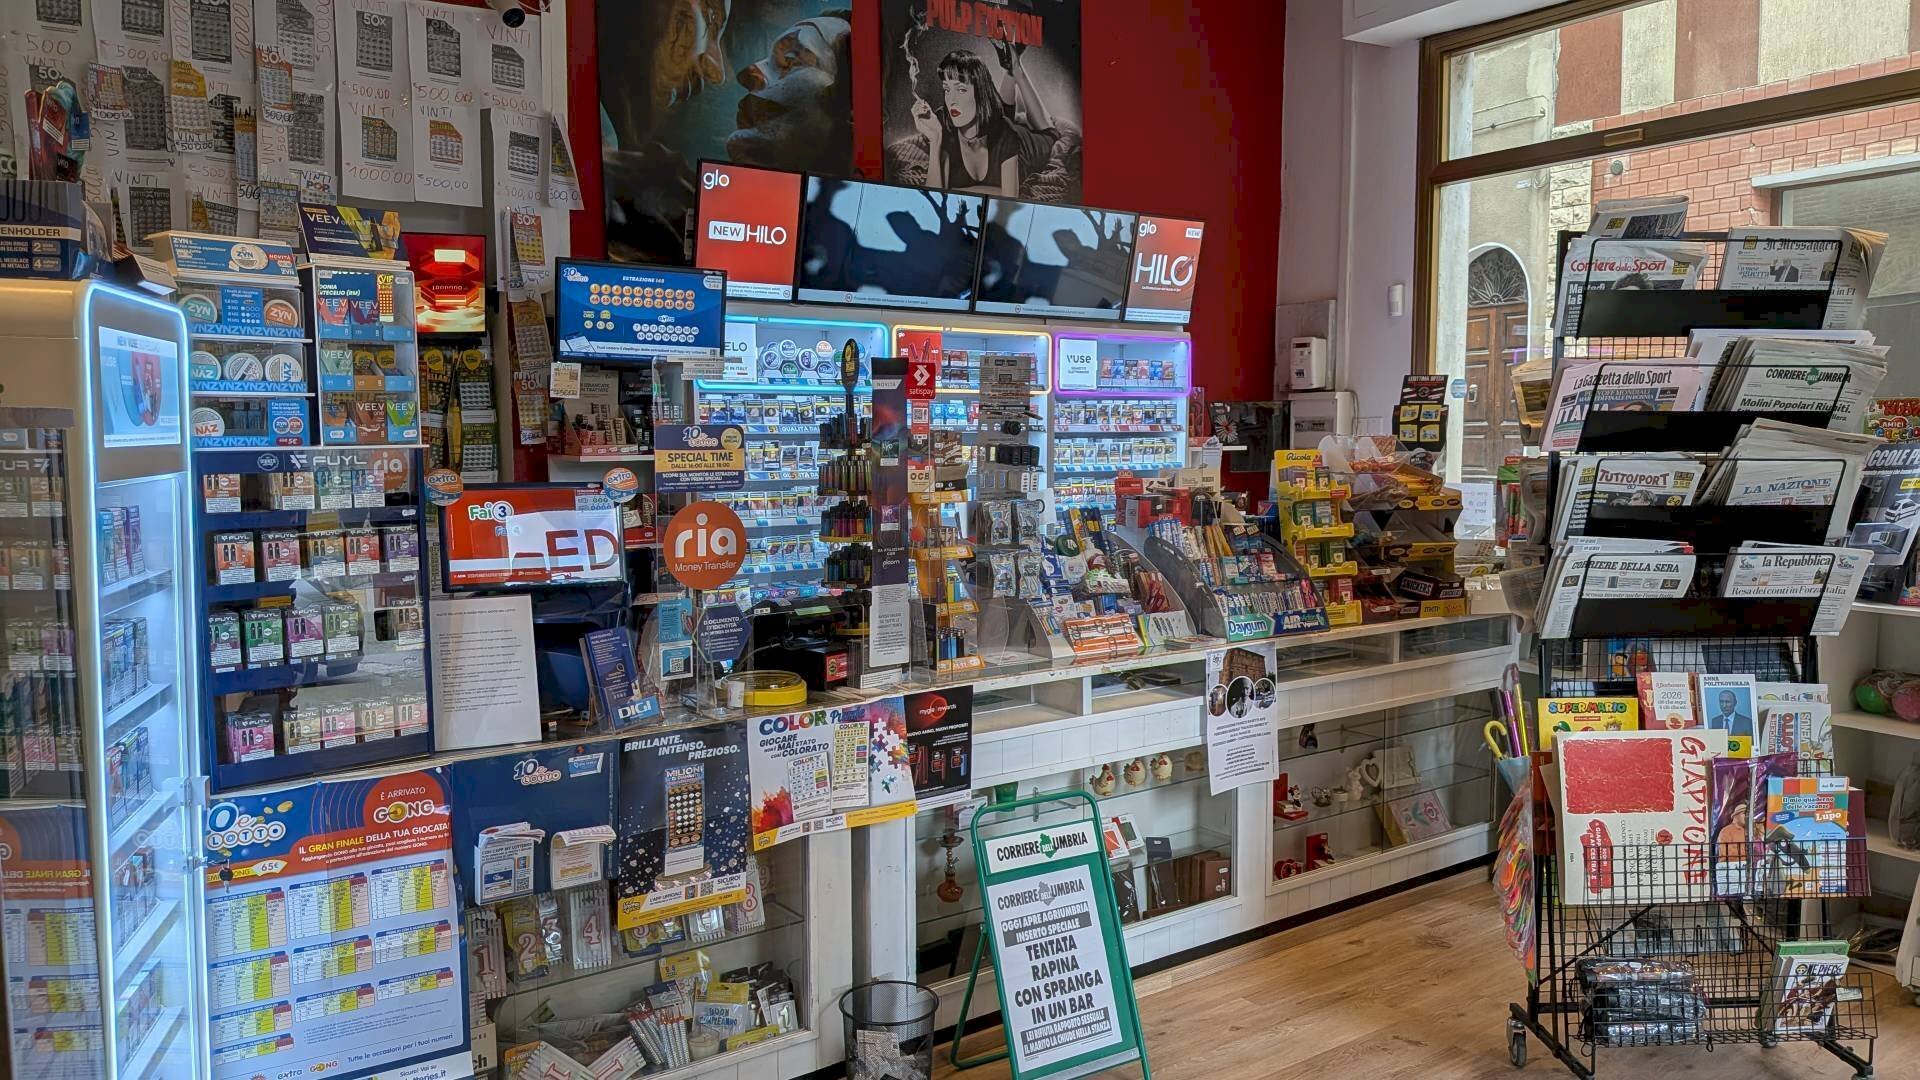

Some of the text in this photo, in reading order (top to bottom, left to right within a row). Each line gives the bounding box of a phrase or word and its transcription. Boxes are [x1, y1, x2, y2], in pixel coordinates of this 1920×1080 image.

[417, 5, 455, 25] VINTI
[925, 0, 1043, 48] PULP FICTION
[487, 24, 531, 49] VINTI
[350, 101, 397, 118] VINTI
[419, 104, 454, 119] VINTI
[113, 168, 160, 187] VINTI
[703, 169, 730, 190] glo
[308, 214, 341, 226] VEEV
[1138, 220, 1157, 237] glo
[713, 224, 787, 246] NEW HILO
[269, 254, 292, 262] NOVITÀ
[1570, 257, 1616, 273] Corriere
[1633, 257, 1667, 274] Sport
[1134, 252, 1195, 287] HILO
[187, 302, 213, 316] ZYN
[270, 307, 294, 321] ZYN
[323, 351, 351, 359] VEEV
[1582, 370, 1622, 388] Gazzetta
[1622, 370, 1645, 385] dello
[1646, 369, 1673, 387] Sport
[1766, 368, 1852, 383] CORRIERE UMBRIA
[909, 387, 934, 398] satispay
[357, 402, 385, 411] VEEV
[387, 403, 416, 411] VEEV
[1740, 398, 1851, 414] Molini Popolari Riuniti.
[313, 455, 367, 467] FUYL
[667, 452, 734, 463] SPECIAL TIME
[1286, 452, 1313, 462] Ricola
[428, 474, 457, 485] extra
[607, 471, 632, 485] extra
[910, 473, 930, 481] OCB
[1600, 469, 1670, 487] TUTTOSPORT
[1743, 478, 1832, 495] LA NAZIONE
[468, 504, 508, 521] Fai 3
[675, 513, 738, 559] ria
[675, 560, 737, 574] Money Transfer
[883, 558, 901, 569] ploom
[1571, 561, 1680, 573] CORRIERE DELLA SERA
[1761, 556, 1831, 569] la Repubblica
[1732, 587, 1752, 596] Resa
[1767, 587, 1789, 595] conti
[1790, 587, 1799, 595] in
[1800, 586, 1823, 596] Forza
[1228, 619, 1267, 637] Daygum
[1661, 691, 1682, 700] 2026
[618, 700, 652, 719] DIGI
[758, 709, 828, 737] COLOR
[1800, 711, 1812, 743] VENUS
[624, 734, 684, 754] BRILLANTE.
[658, 740, 708, 757] INTENSO.
[759, 733, 799, 748] GIOCARE
[777, 738, 817, 752] MAI STATO
[687, 744, 742, 762] PREZIOSO.
[781, 742, 830, 759] COLORATO
[513, 758, 562, 786] 10 LOTTO
[387, 786, 427, 799] ARRIVATO
[373, 799, 435, 824] GONG
[1680, 735, 1708, 886] GIAPPONE
[1815, 811, 1842, 822] Lupo
[207, 820, 286, 851] LOTTO
[299, 845, 307, 855] IL
[308, 841, 335, 854] GRAN
[335, 835, 366, 849] FINALE
[365, 832, 393, 843] DELLA
[392, 828, 411, 840] TUA
[996, 837, 1041, 862] CORRIERE
[1052, 831, 1089, 850] UMBRIA
[261, 861, 281, 873] 65€
[997, 888, 1040, 911] CORRIERE
[1050, 878, 1086, 898] UMBRIA
[1001, 902, 1090, 933] OGGI APRE AGRIUMBRIA
[583, 914, 601, 945] 4
[1016, 920, 1081, 944] INSERTO SPECIALE
[1025, 934, 1078, 962] TENTATA
[1031, 954, 1080, 982] RAPINA
[1014, 968, 1104, 1008] CON SPRANGA
[1031, 992, 1095, 1026] IN UN BAR
[1025, 1030, 1034, 1041] LEI
[1053, 1016, 1082, 1034] RAPPORTO
[1080, 1009, 1105, 1026] SESSUALE
[1075, 1024, 1092, 1039] NELLA
[347, 1032, 454, 1063] Tutte le occasioni per tuoi numeri
[309, 1059, 339, 1074] GONG
